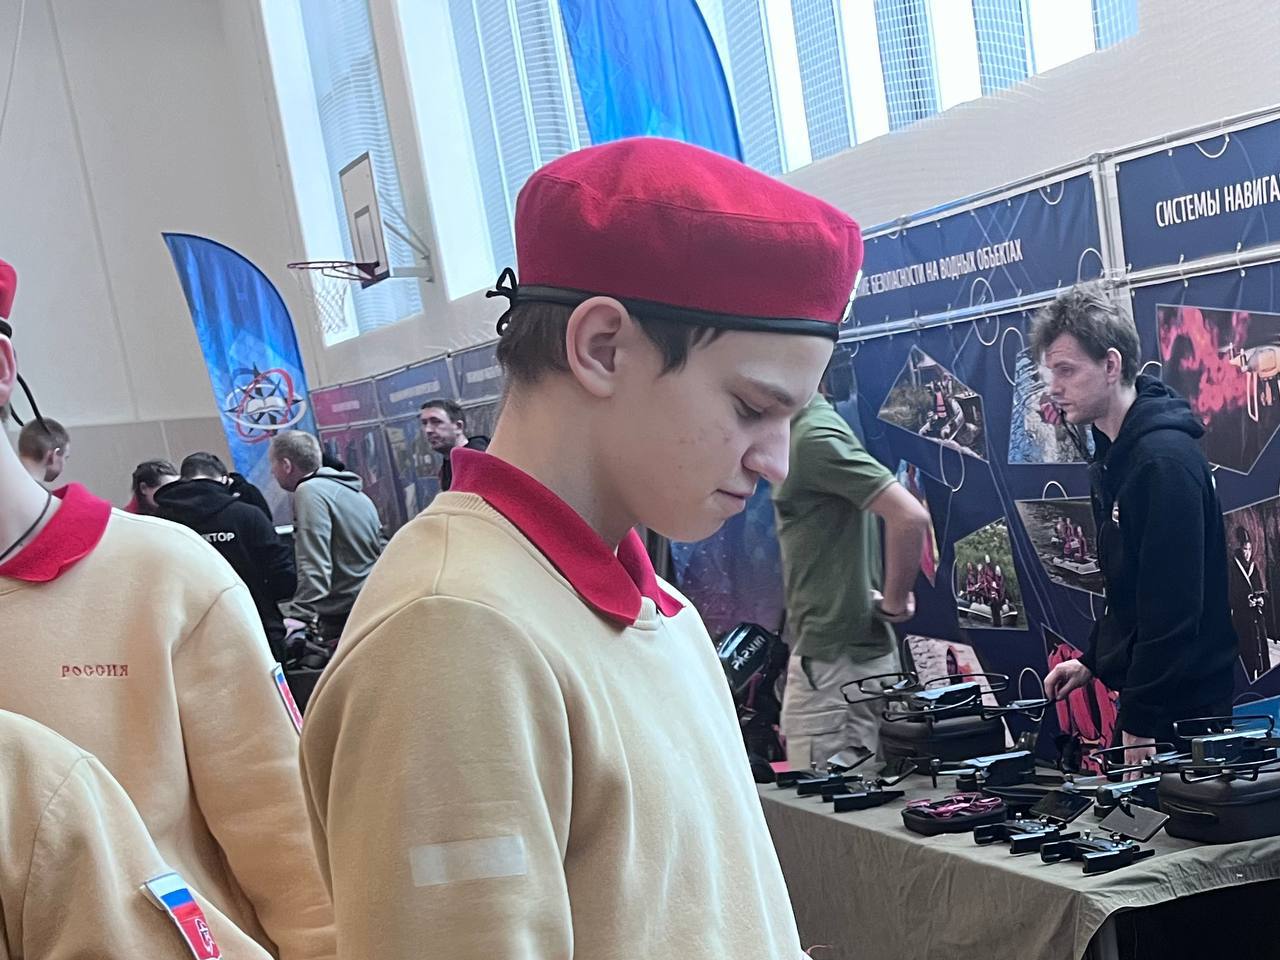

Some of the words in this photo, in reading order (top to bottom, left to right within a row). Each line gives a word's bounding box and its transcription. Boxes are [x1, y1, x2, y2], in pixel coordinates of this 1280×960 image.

[1156, 188, 1220, 227] СИСТЕМЫ
[870, 263, 926, 294] БЕЗОПАСНОСТИ
[925, 260, 940, 282] НА
[940, 251, 977, 280] ВОДНЫХ
[976, 238, 1023, 271] ОБЪЕКТАХ
[61, 664, 129, 678] РОССИЯ
